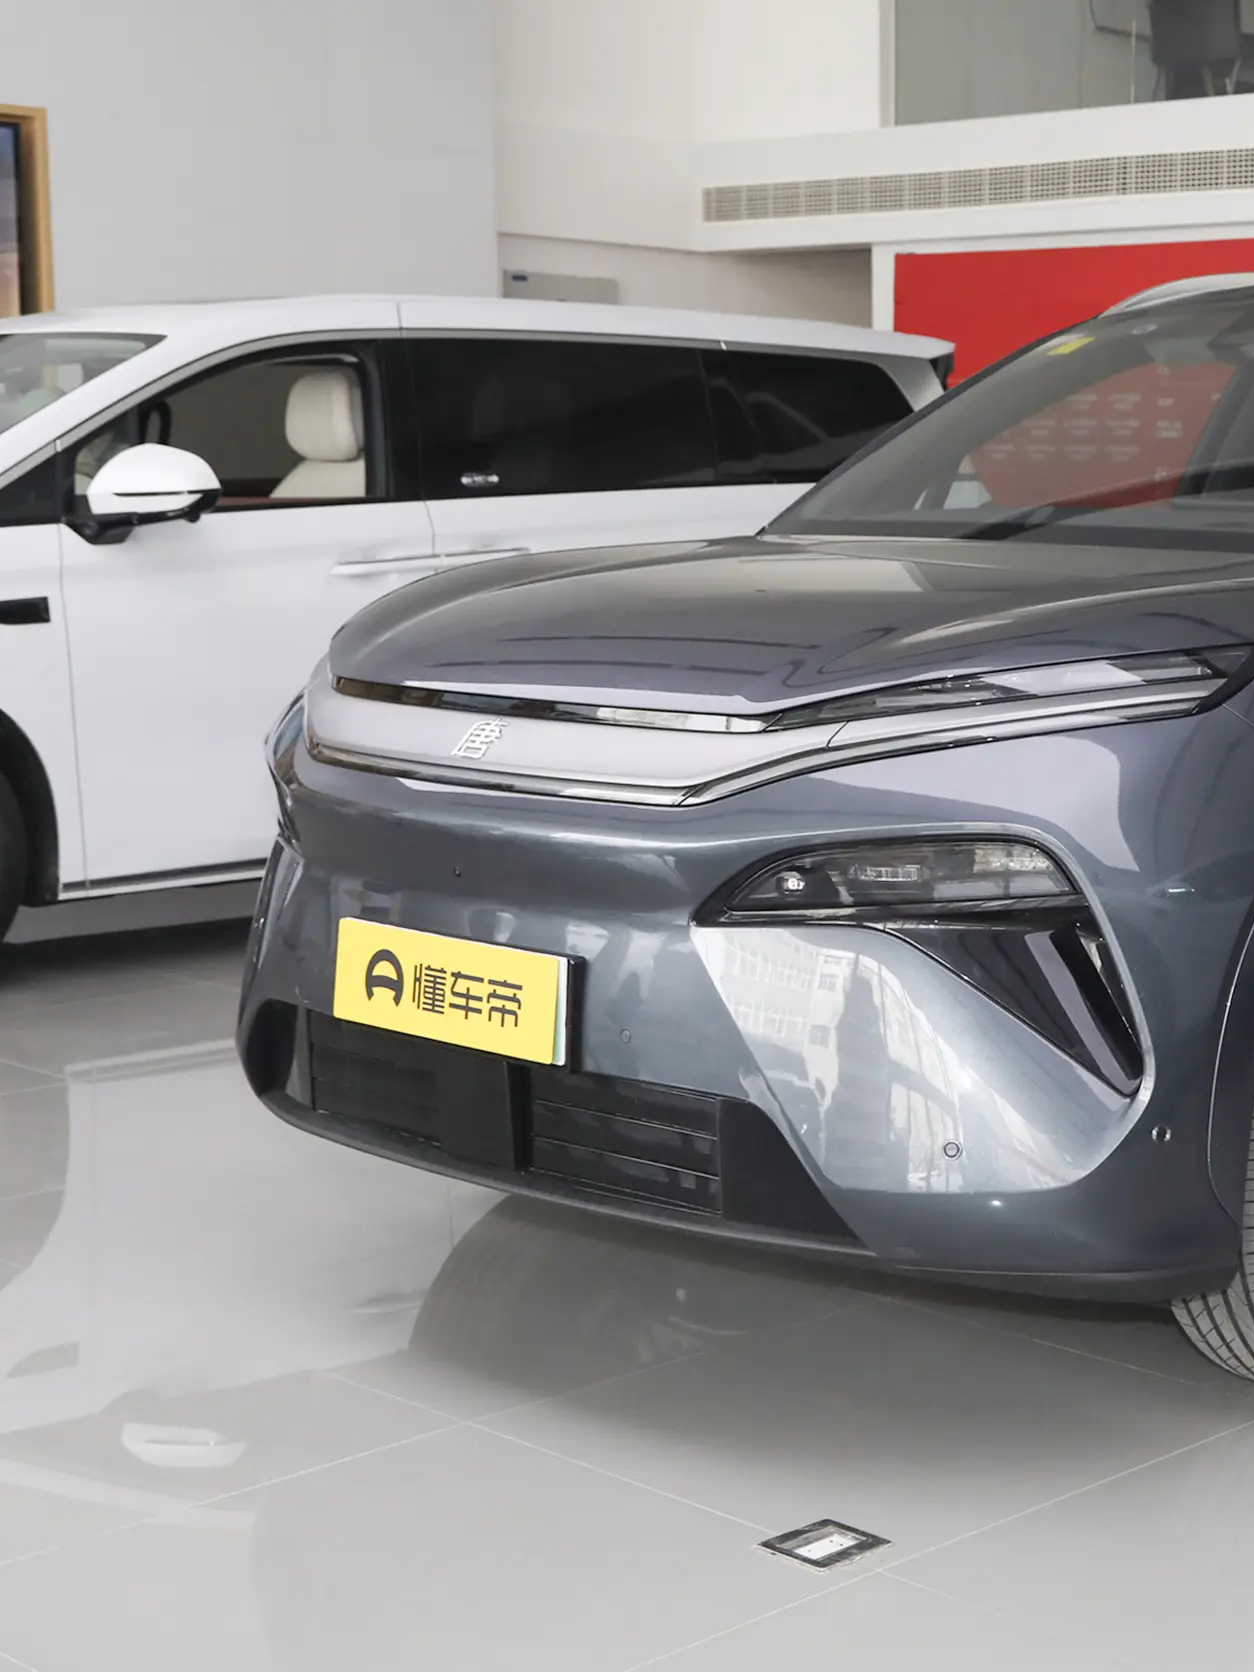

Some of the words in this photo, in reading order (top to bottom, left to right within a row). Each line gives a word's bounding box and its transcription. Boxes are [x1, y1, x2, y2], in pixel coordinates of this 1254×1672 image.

[450, 716, 510, 760] 唐
[412, 963, 523, 1028] 懂车帝
